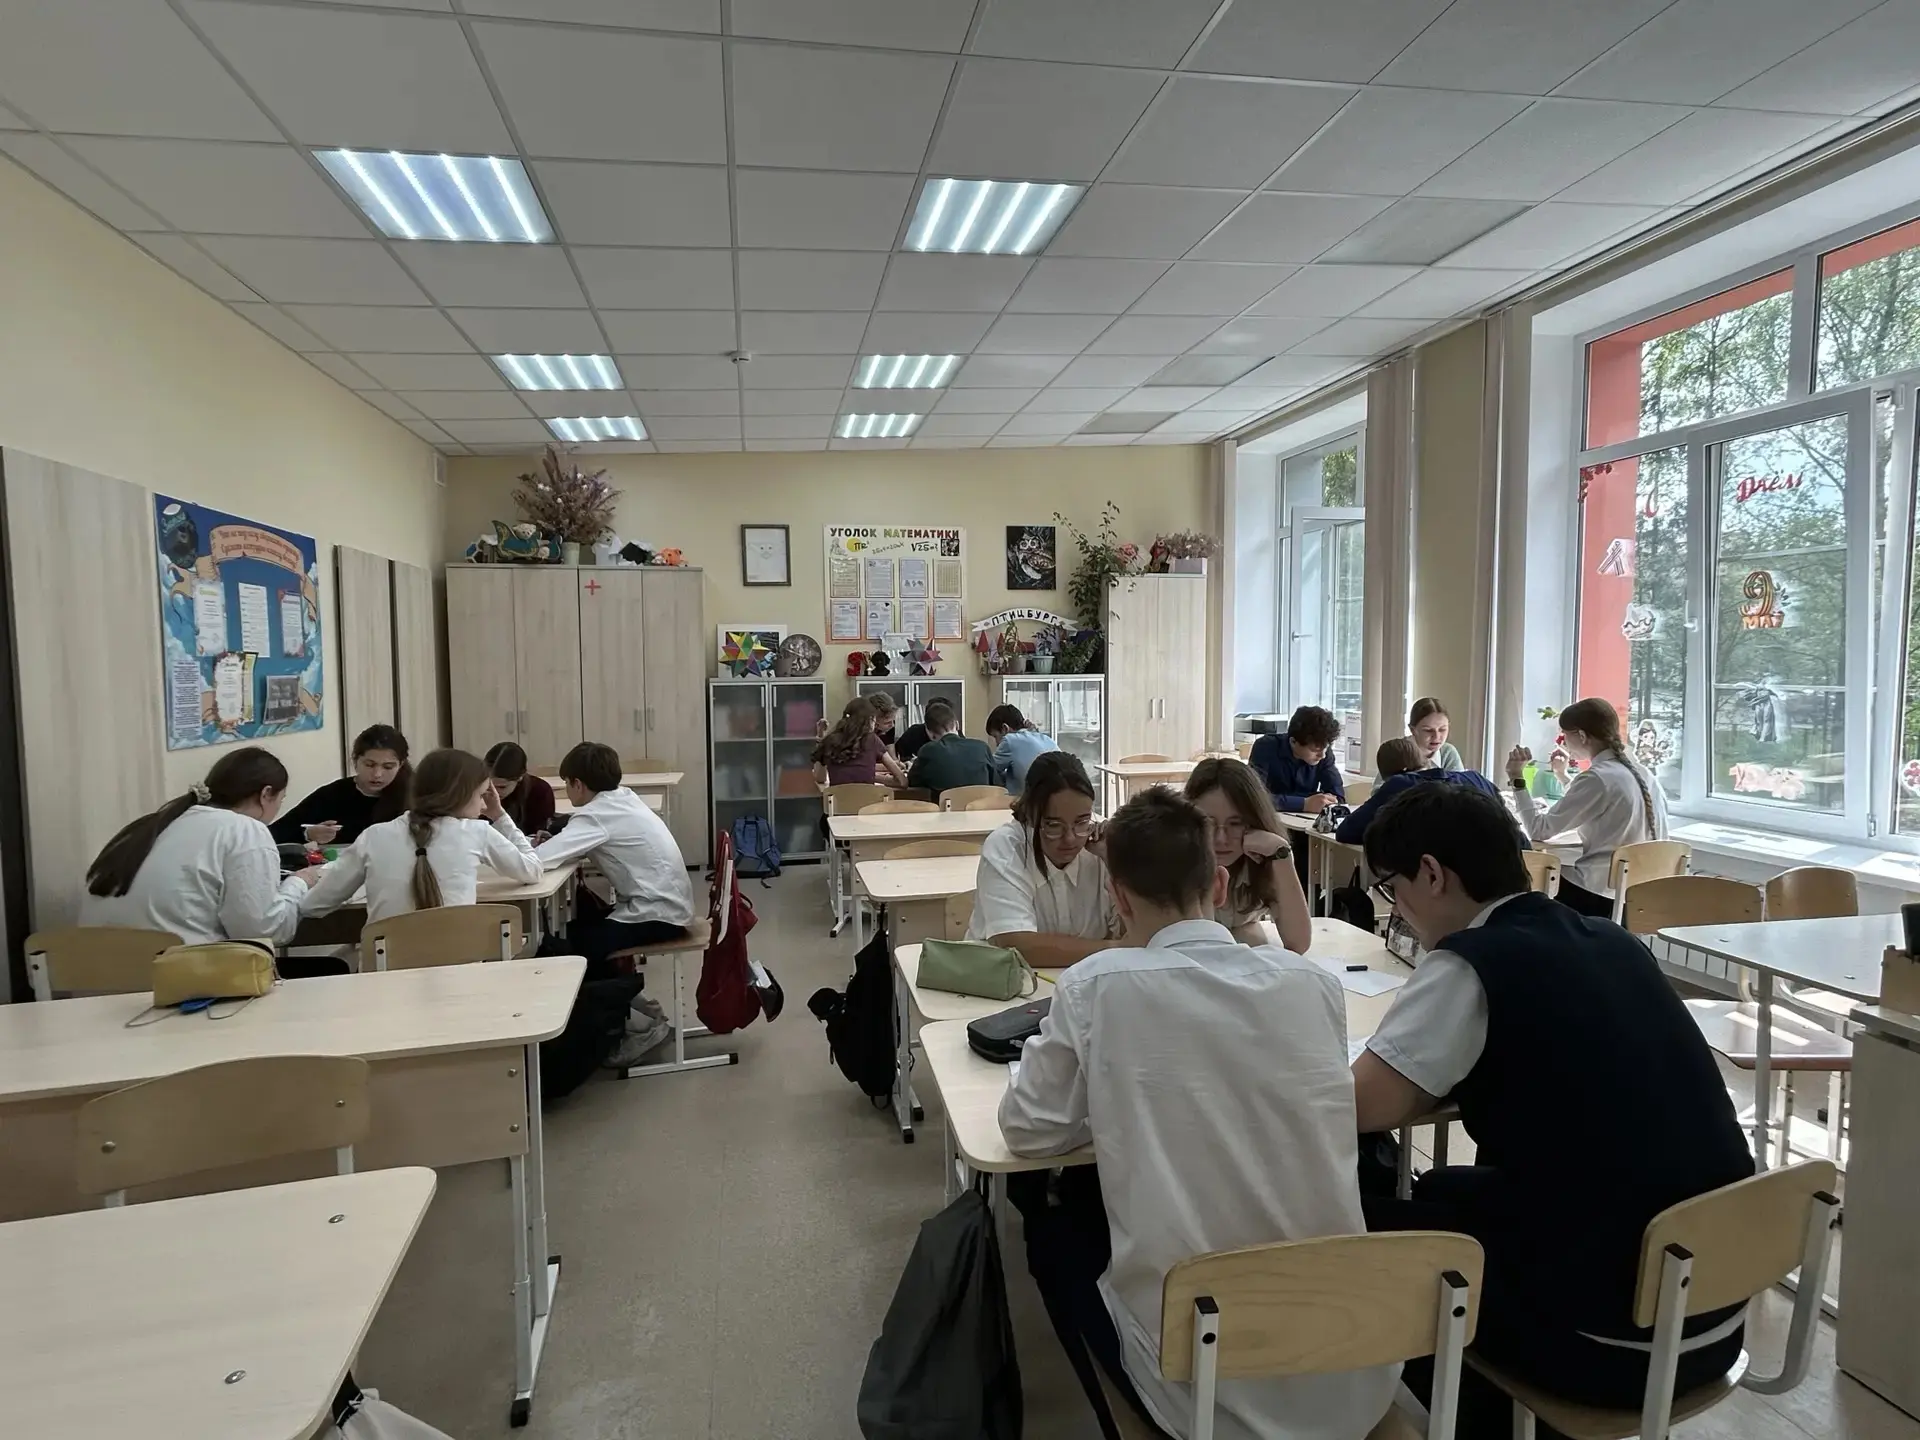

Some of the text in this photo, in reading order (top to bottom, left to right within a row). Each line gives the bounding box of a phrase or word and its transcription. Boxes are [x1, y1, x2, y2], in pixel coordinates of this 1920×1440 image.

[829, 527, 959, 539] УГОЛОК МАТЕМАТИКИ
[1739, 571, 1772, 615] 9
[991, 609, 1057, 626] ПТИЦБУРГ
